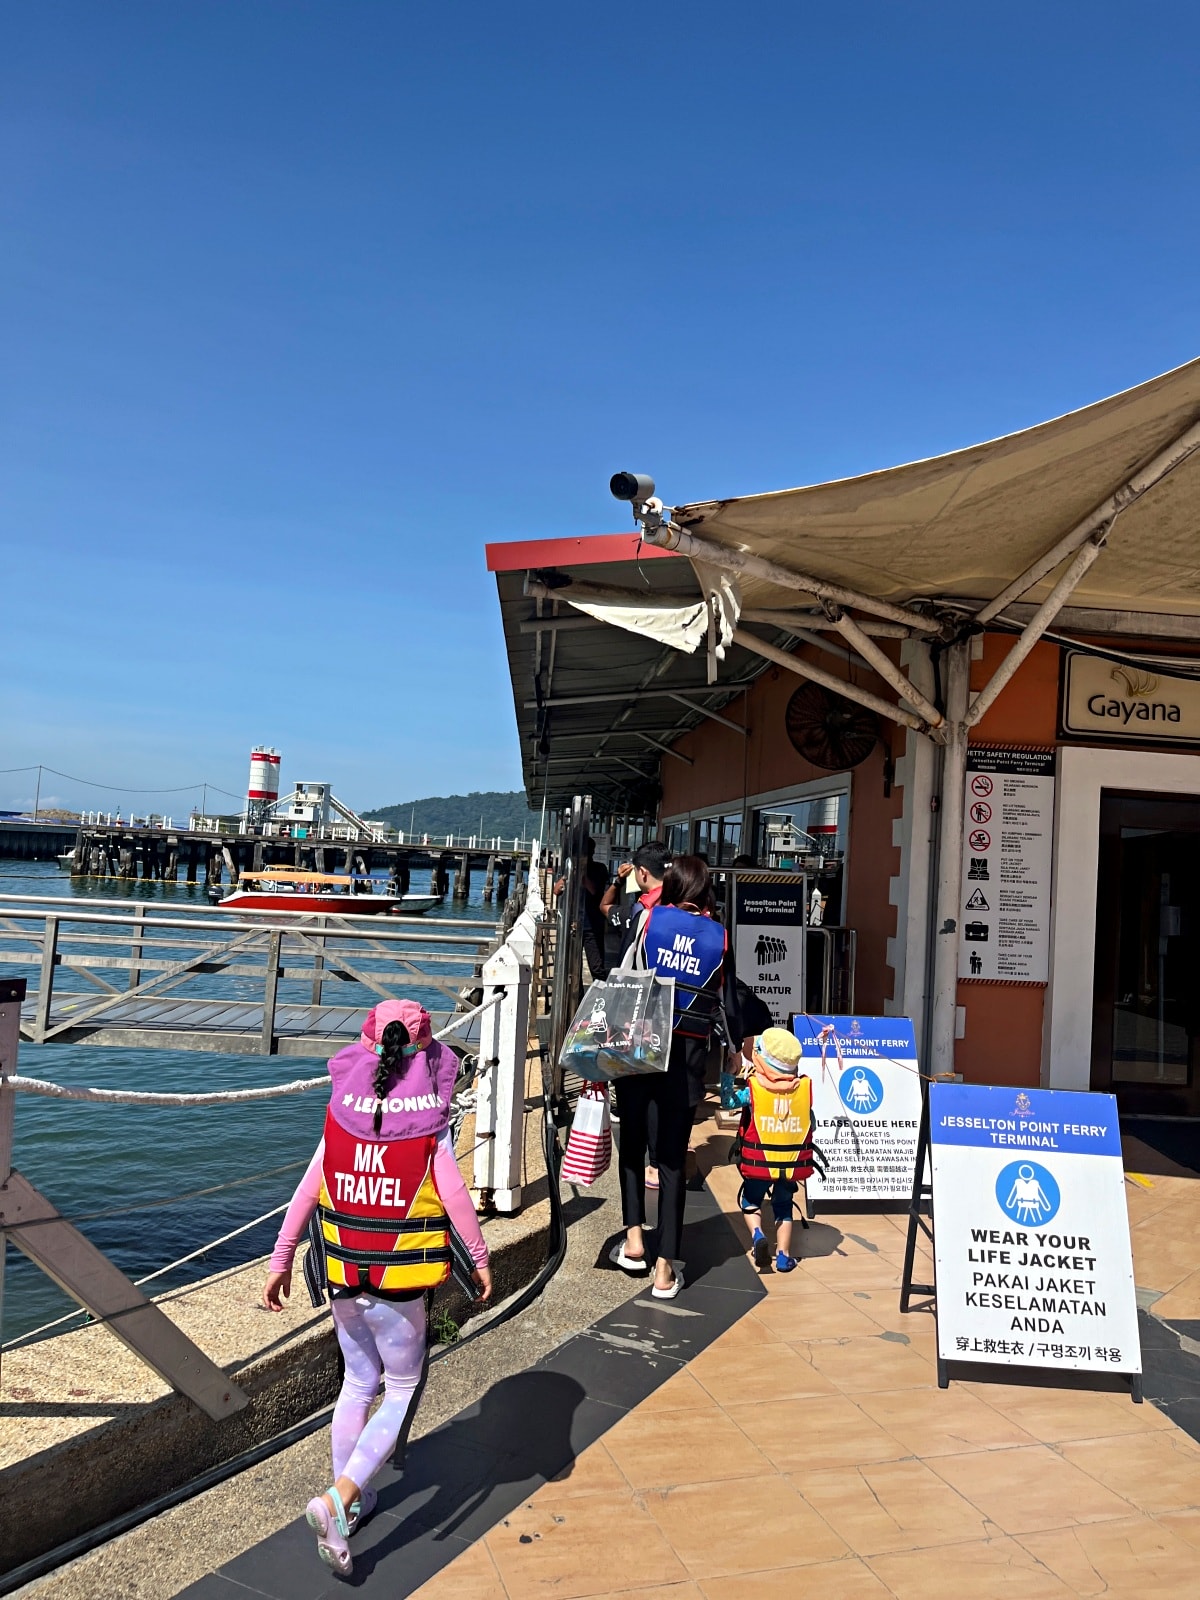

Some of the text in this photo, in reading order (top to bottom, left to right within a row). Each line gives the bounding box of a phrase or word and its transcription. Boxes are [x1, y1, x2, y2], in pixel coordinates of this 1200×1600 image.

[1087, 694, 1181, 725] Gayana
[987, 751, 1011, 759] SAFETY
[1012, 753, 1051, 761] REGULATION
[745, 906, 795, 914] Ferry Terminal
[673, 933, 695, 955] MK
[656, 947, 701, 976] TRAVEL
[758, 973, 781, 982] SILA
[854, 1039, 880, 1047] POINT
[881, 1039, 910, 1048] FERRY
[773, 1098, 793, 1116] MK
[760, 1115, 803, 1133] TRAVEL
[816, 1119, 918, 1129] LEASE QUEUE HERE
[940, 1116, 1108, 1137] JESSELTON POINT FERRY
[990, 1132, 1059, 1148] TERMINAL
[353, 1142, 389, 1174] MK
[334, 1171, 406, 1207] TRAVEL
[971, 1229, 1091, 1251] WEAR YOUR
[968, 1248, 1097, 1271] LIFE JACKET
[973, 1272, 1096, 1295] PAKAI JAKET
[965, 1291, 1106, 1317] KESELAMATAN
[1010, 1316, 1064, 1334] ANDA
[955, 1336, 1025, 1356] 穿上救生衣
[1094, 1346, 1122, 1363] 착용
